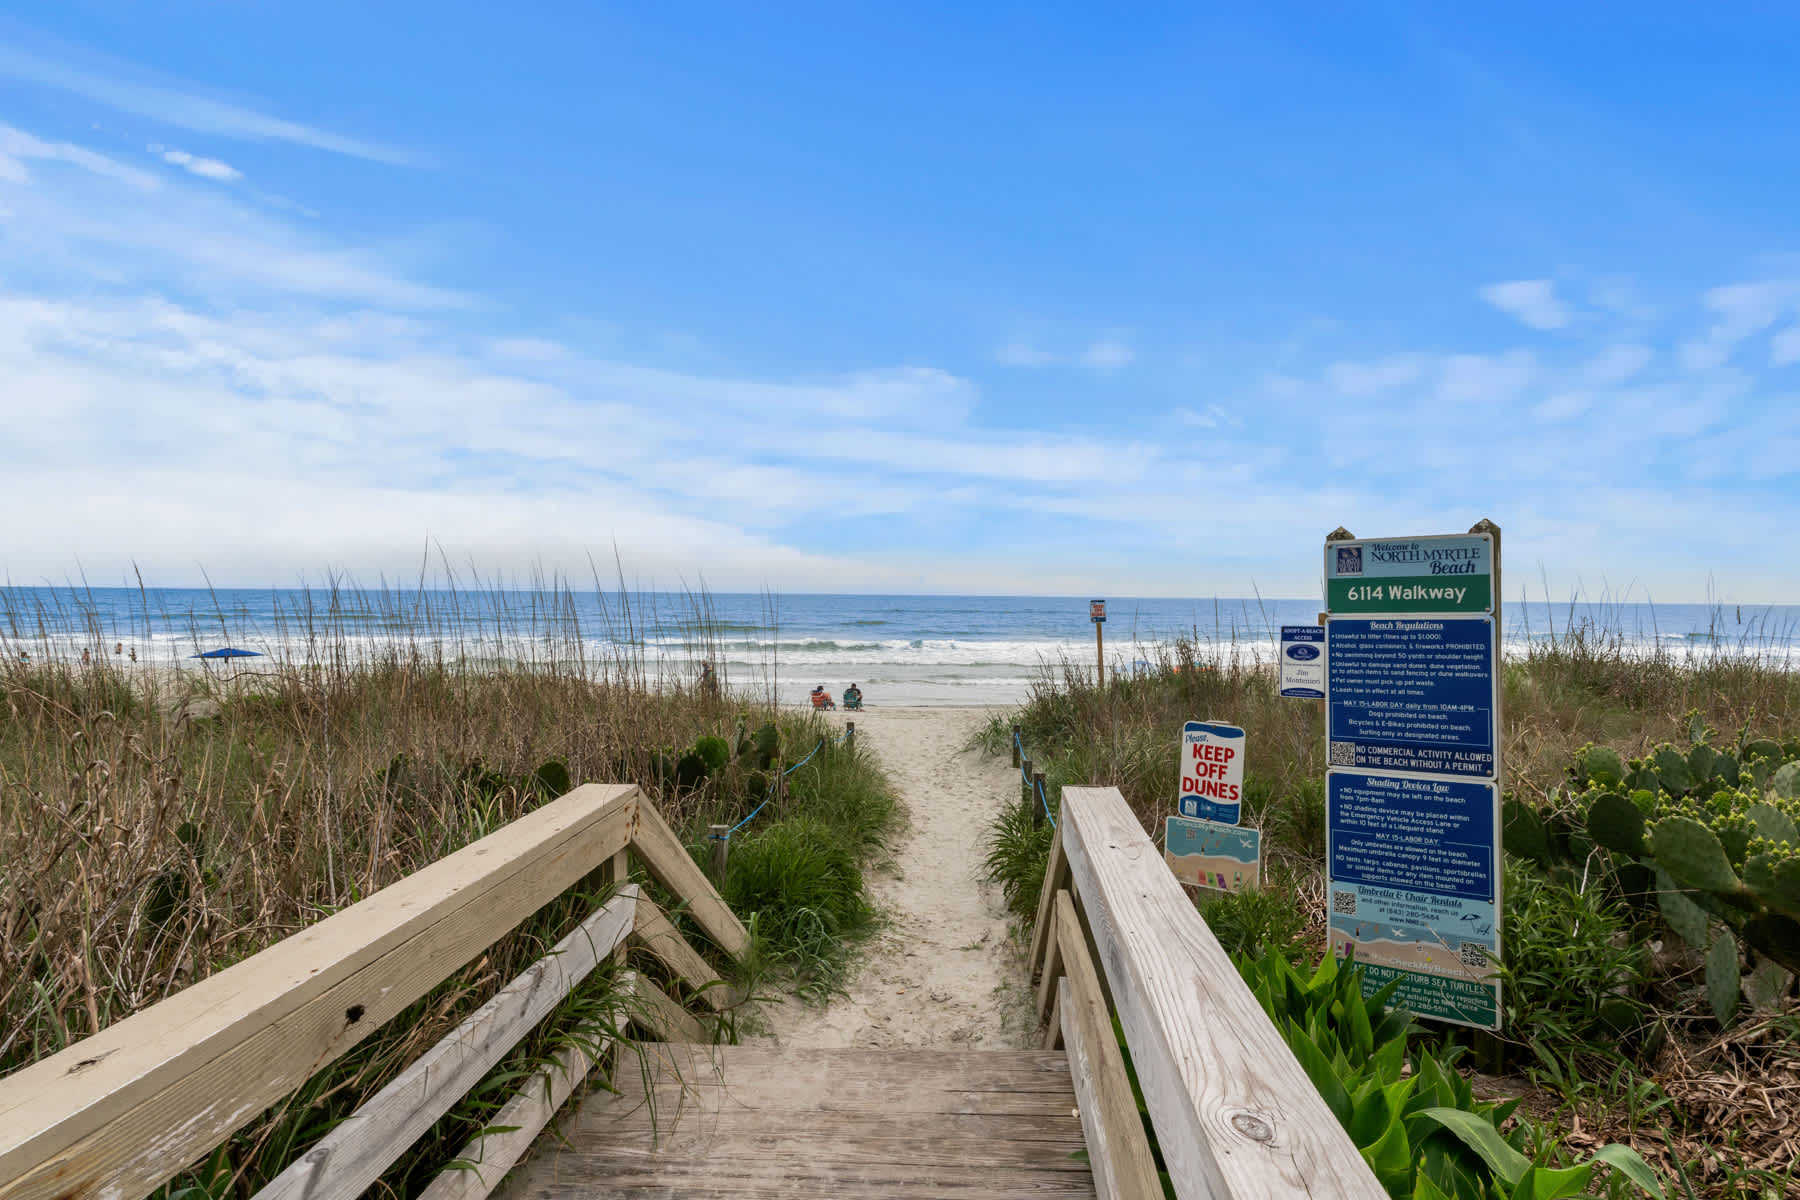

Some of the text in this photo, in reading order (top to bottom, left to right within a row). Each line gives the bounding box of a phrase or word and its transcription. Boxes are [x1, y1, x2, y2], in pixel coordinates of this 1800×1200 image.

[1373, 542, 1420, 552] Welcome to
[1371, 548, 1480, 563] NORTH MYRTLE
[1430, 560, 1476, 575] Beach
[1347, 585, 1467, 604] 6114 Walkway
[1370, 622, 1444, 631] Beach Regulations
[1343, 700, 1357, 708] MAY
[1389, 702, 1404, 710] DAY
[1368, 711, 1384, 719] Dogs
[1348, 719, 1374, 727] Bicycles
[1406, 722, 1440, 730] prohibited
[1359, 729, 1381, 737] Surfing
[1381, 731, 1396, 739] only
[1192, 743, 1235, 763] KEEP
[1355, 745, 1492, 762] NO COMMERCIAL ACTIVITY ALLOWED
[1355, 755, 1366, 764] ON
[1368, 756, 1382, 765] THE
[1383, 757, 1409, 767] BEACH
[1409, 759, 1442, 769] WITHOUT
[1195, 761, 1229, 781] OFF
[1182, 776, 1240, 801] DUNES
[1366, 777, 1450, 794] Shading Devices Law
[1386, 792, 1401, 800] may
[1350, 811, 1385, 822] Emergency
[1386, 815, 1410, 823] Vehicle
[1410, 818, 1434, 826] Access
[1353, 805, 1378, 814] shading
[1400, 810, 1415, 818] may
[1425, 812, 1448, 820] placed
[1350, 839, 1364, 848] Only
[1364, 841, 1393, 850] umbrellas
[1375, 833, 1390, 841] MAY
[1338, 844, 1368, 854] Maximum
[1368, 848, 1397, 857] umbrella
[1397, 852, 1421, 862] canopy
[1404, 870, 1418, 879] any
[1435, 874, 1465, 884] mounted
[1357, 885, 1395, 899] Umbrella
[1404, 892, 1429, 903] Chair
[1430, 895, 1463, 908] Rentals
[1369, 967, 1380, 976] DO
[1380, 968, 1395, 978] NOT
[1431, 977, 1447, 988] SEA
[1449, 981, 1486, 993] TURTLES
